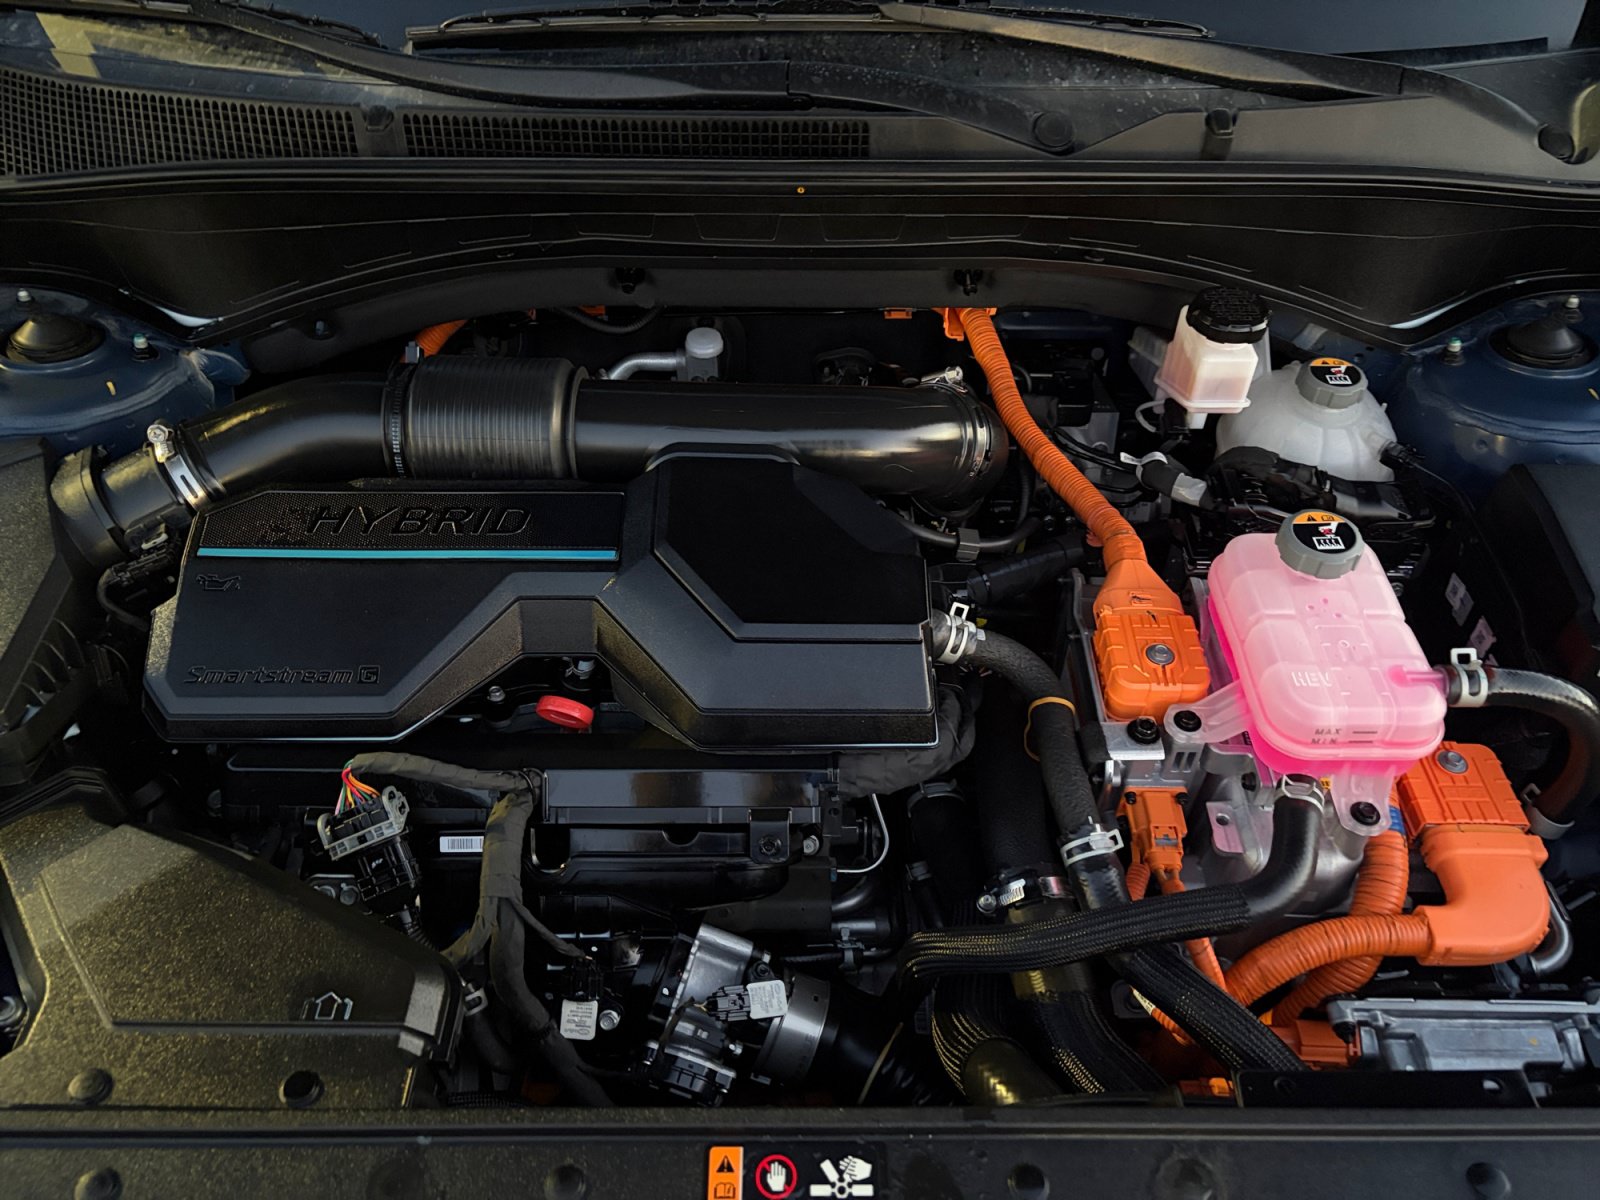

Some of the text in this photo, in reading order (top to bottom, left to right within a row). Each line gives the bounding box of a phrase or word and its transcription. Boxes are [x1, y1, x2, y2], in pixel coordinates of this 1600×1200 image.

[303, 505, 533, 537] HYBRID
[184, 665, 354, 685] Smartstream
[1314, 728, 1342, 736] MAX
